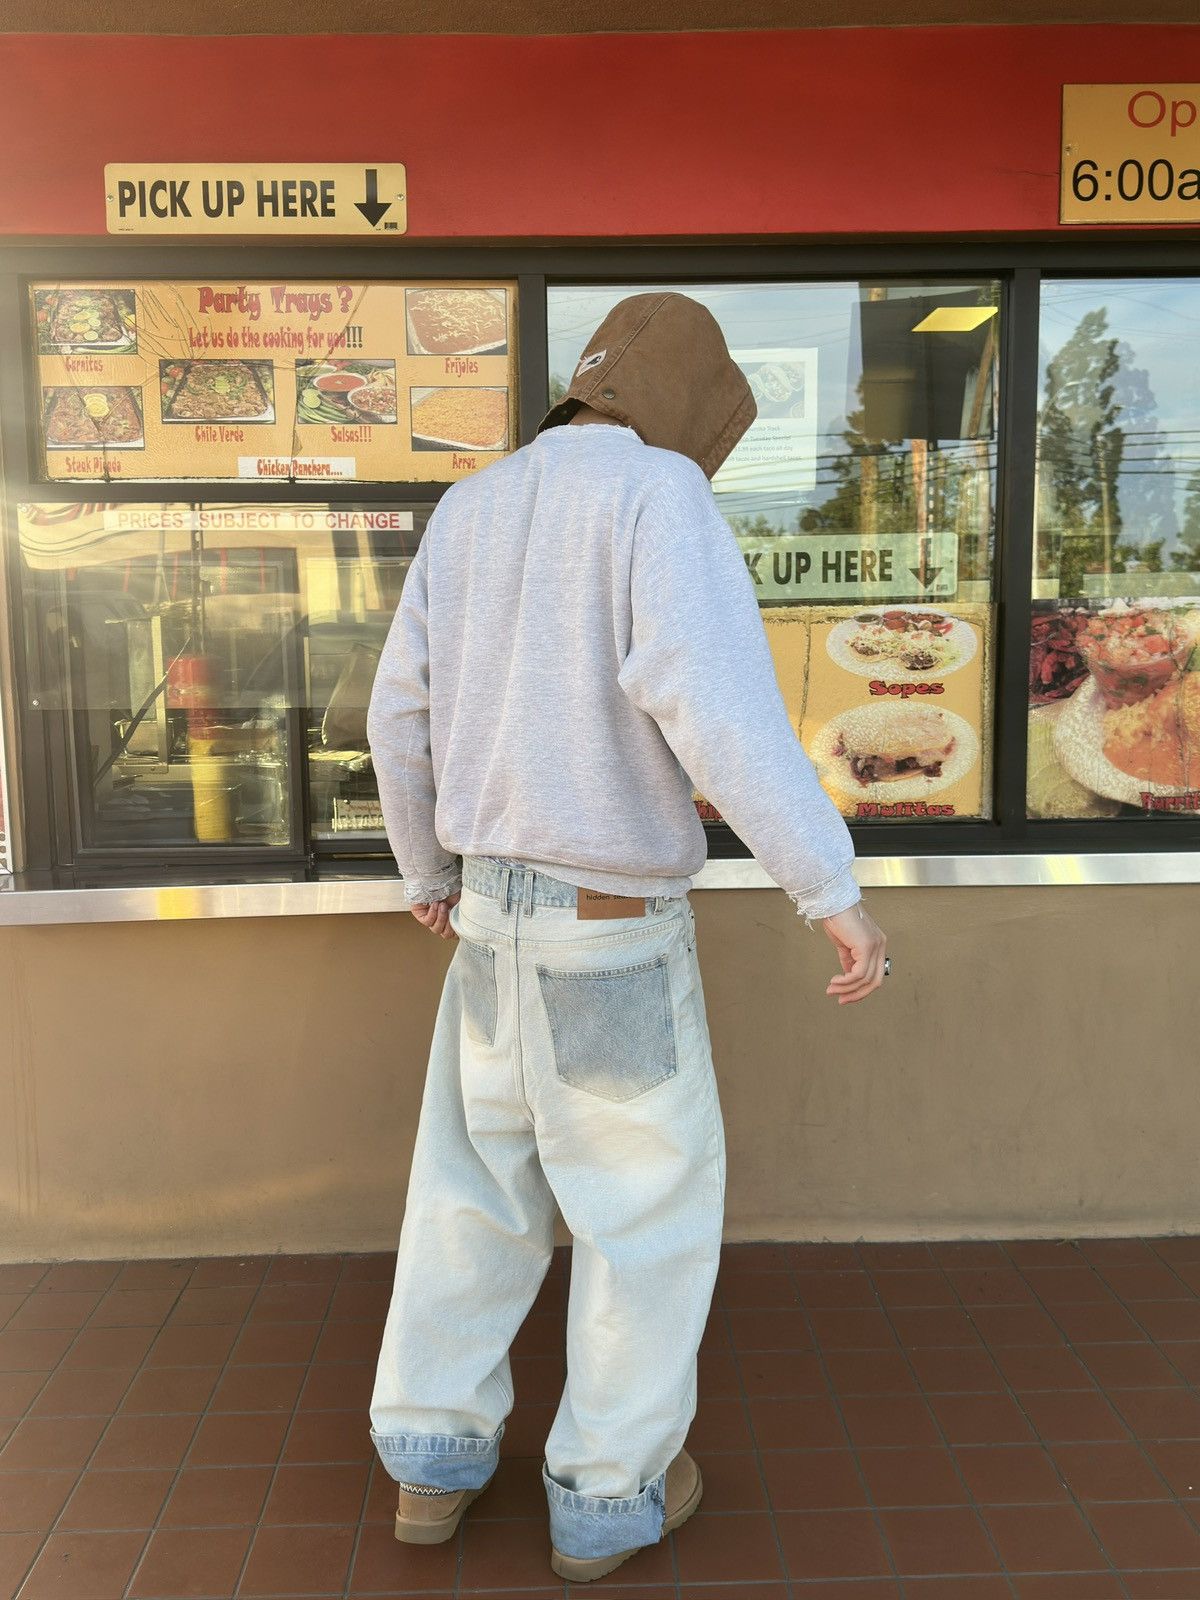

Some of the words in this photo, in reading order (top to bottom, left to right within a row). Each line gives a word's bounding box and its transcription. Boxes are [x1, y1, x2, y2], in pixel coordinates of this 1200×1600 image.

[118, 180, 192, 218] PICK
[201, 180, 245, 218] UP
[257, 180, 336, 218] HERE
[198, 286, 261, 321] Party
[270, 285, 333, 321] Trays
[189, 326, 210, 348] Let
[211, 332, 224, 348] us
[227, 326, 239, 348] do
[241, 326, 260, 348] the
[263, 326, 304, 354] cooking
[306, 326, 324, 348] for
[444, 357, 479, 377] Frijoles
[195, 425, 217, 442] Chile
[219, 425, 244, 442] Verde
[330, 425, 372, 443] Salsas!!!
[65, 456, 91, 473] Steak
[452, 453, 476, 469] Arroz
[118, 512, 183, 528] PRICES
[199, 512, 280, 529] SUBJECT
[292, 512, 315, 529] TO
[325, 512, 400, 529] CHANGE
[773, 552, 812, 585] UP
[822, 550, 893, 584] HERE
[869, 680, 945, 699] Sopes
